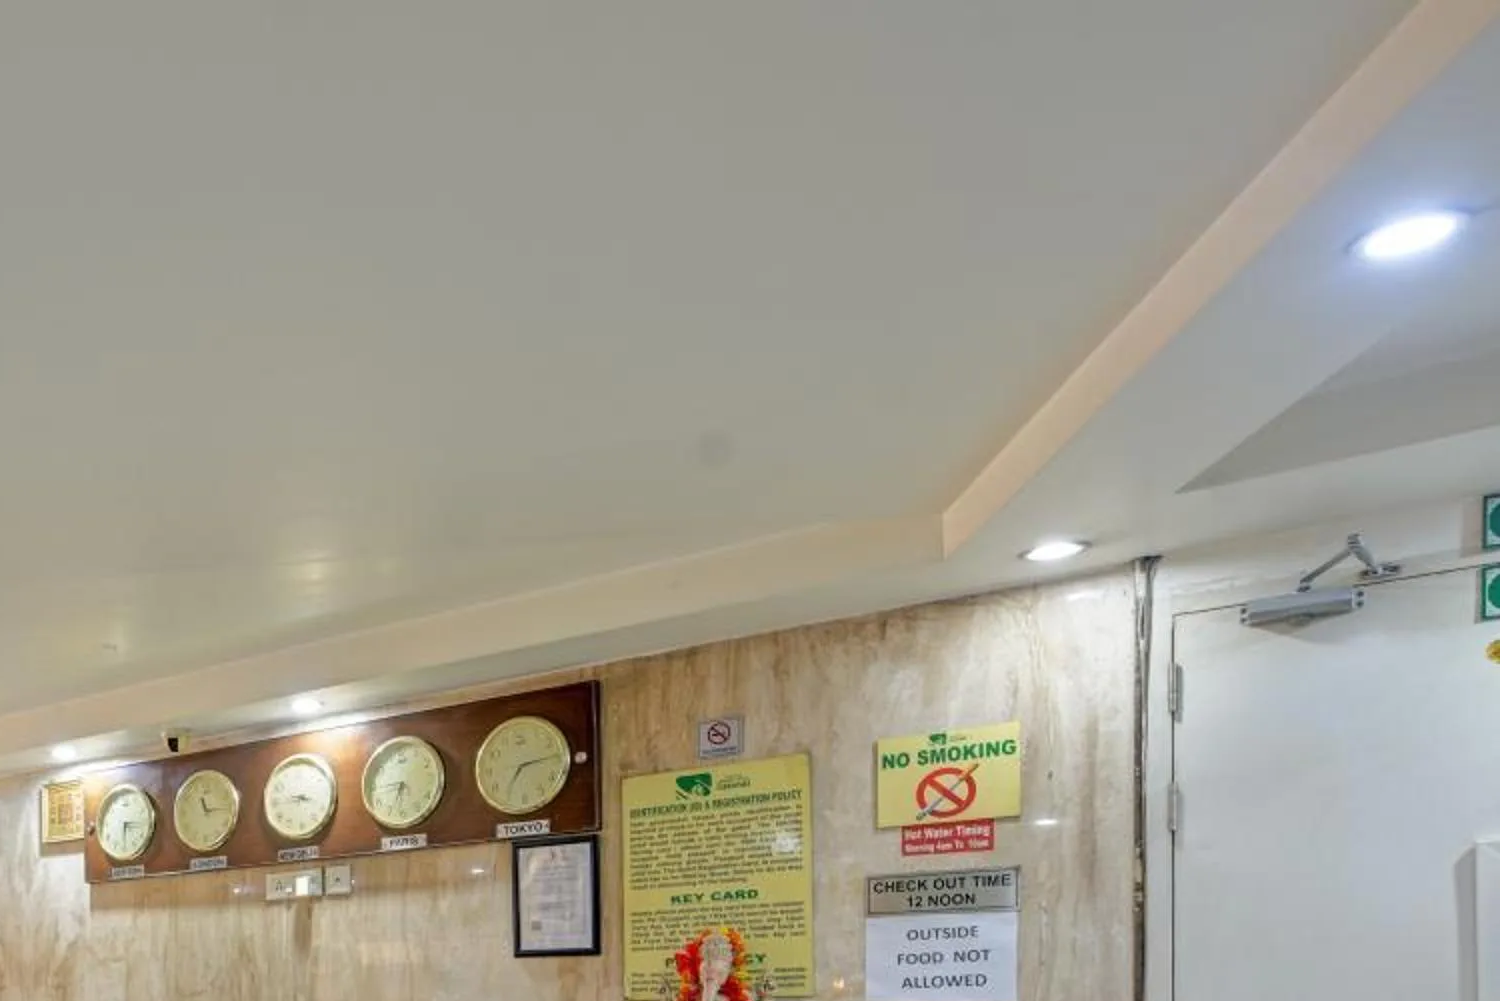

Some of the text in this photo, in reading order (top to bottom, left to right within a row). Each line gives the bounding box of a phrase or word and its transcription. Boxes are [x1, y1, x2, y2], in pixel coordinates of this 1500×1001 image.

[882, 740, 1017, 769] NO SMOKING
[504, 821, 543, 835] TOKYO
[924, 826, 953, 840] Water
[873, 873, 1012, 895] CHECK OUT TIME
[670, 889, 760, 905] KEY CARD
[907, 893, 977, 908] 12 NOON
[906, 925, 980, 942] OUTSIDE
[897, 949, 992, 966] FOOD NOT
[901, 973, 988, 990] ALLOWED
